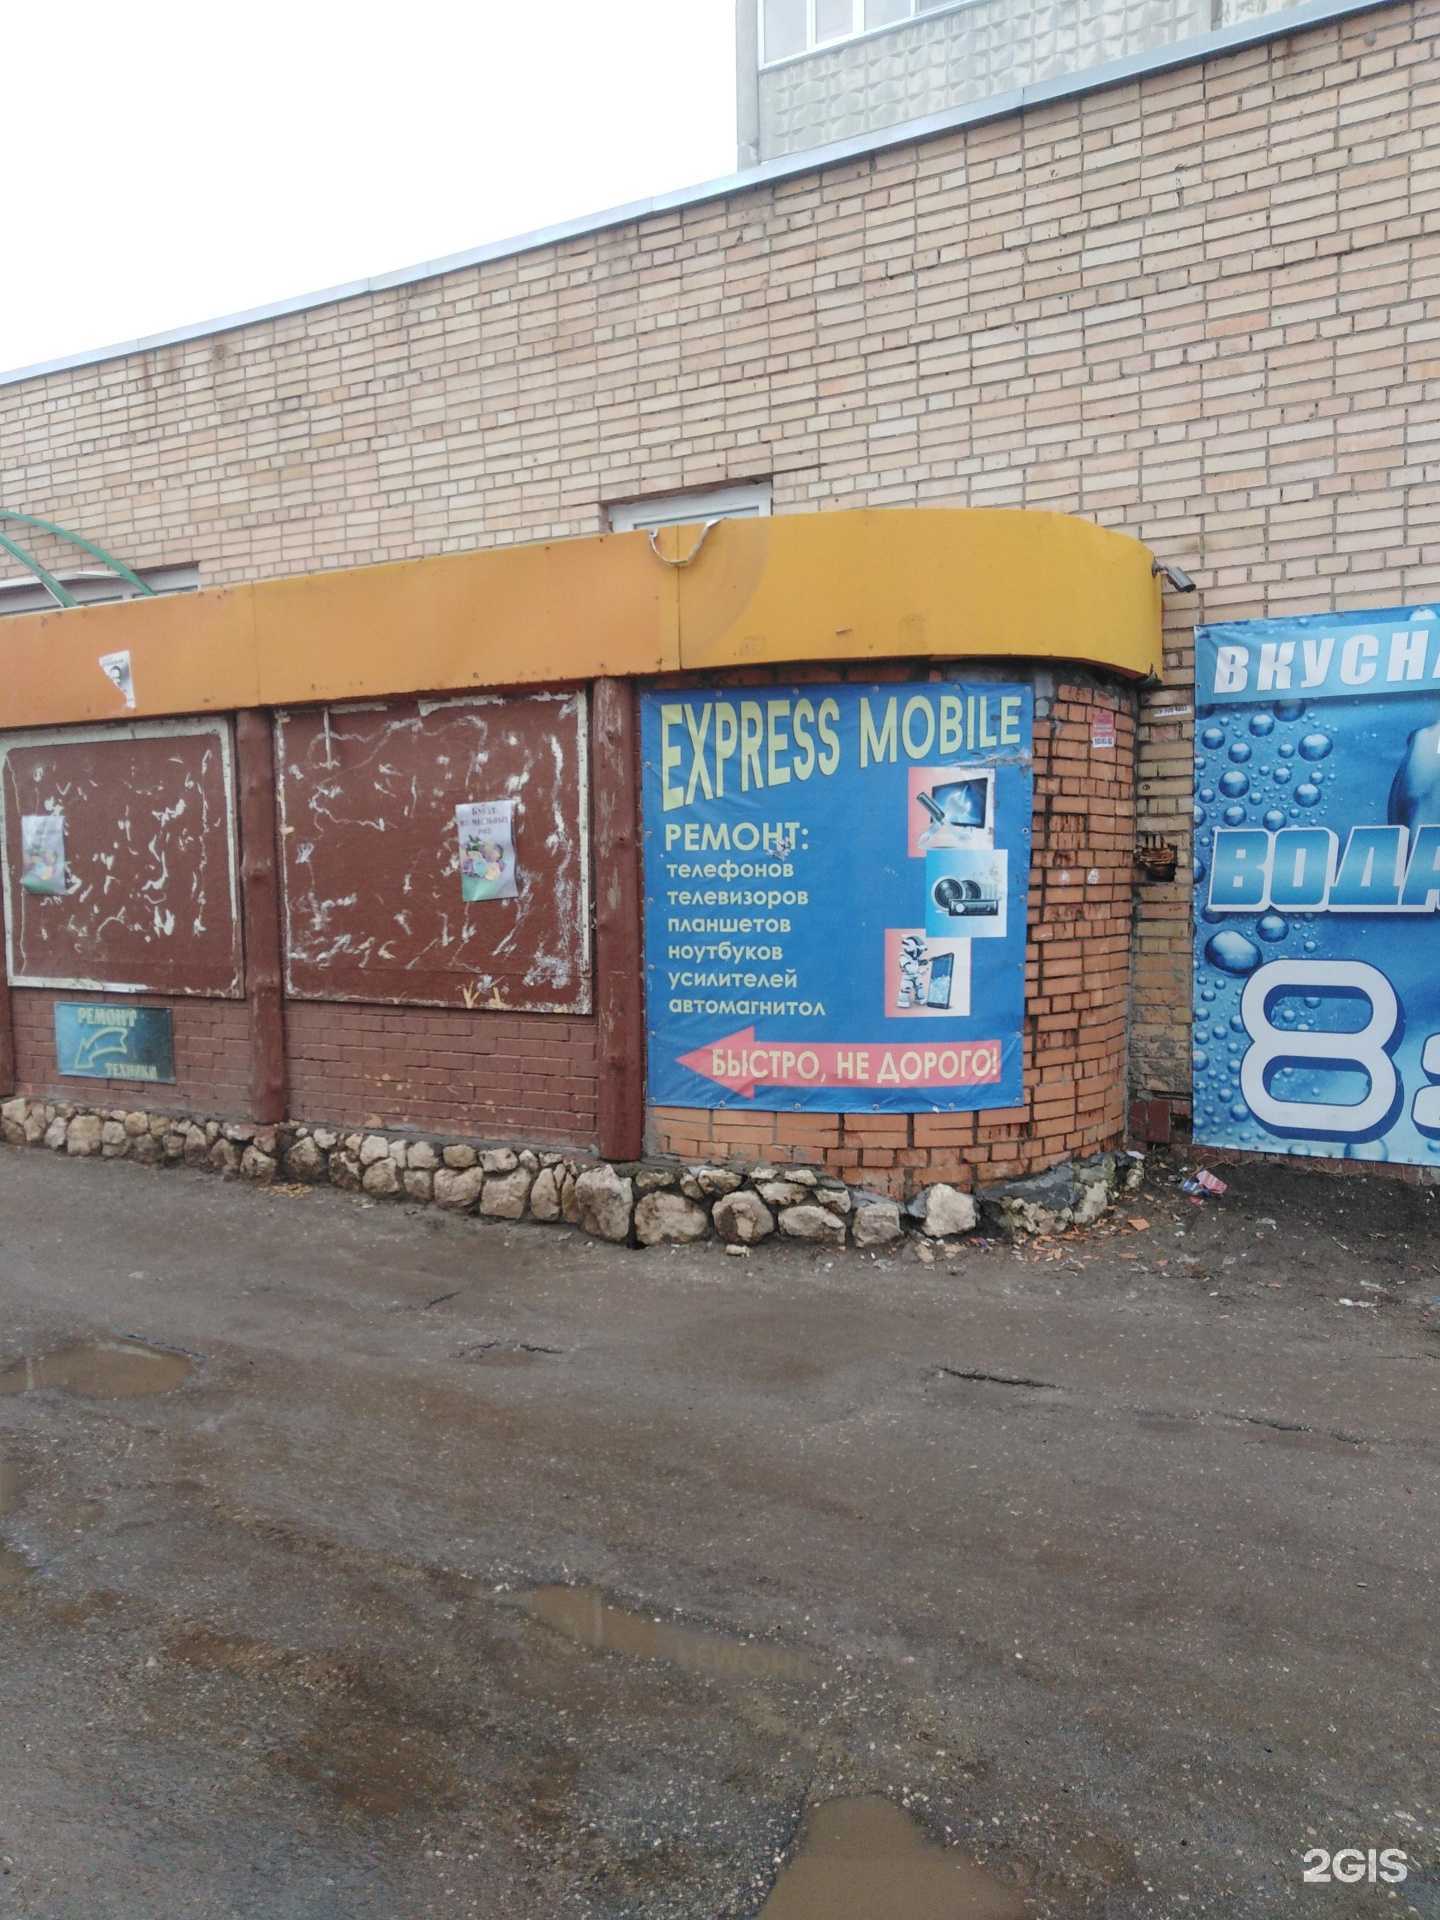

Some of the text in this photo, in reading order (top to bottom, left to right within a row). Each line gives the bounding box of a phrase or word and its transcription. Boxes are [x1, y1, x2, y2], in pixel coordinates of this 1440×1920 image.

[1213, 627, 1440, 695] ВКУСН
[660, 695, 1022, 813] EXPRESS MOBILE
[665, 822, 809, 851] РЕМОНТ:
[666, 859, 794, 882] телефонов
[667, 890, 809, 909] телевизоров
[667, 917, 792, 933] планшетов
[667, 941, 784, 964] ноутбуков
[668, 968, 798, 990] усилителей
[77, 1007, 137, 1028] РЕМОНТ
[669, 998, 826, 1017] автомагнитол
[1240, 958, 1440, 1144] 8
[711, 1047, 999, 1083] БЫСТРО, НЕ ДОРОГО!
